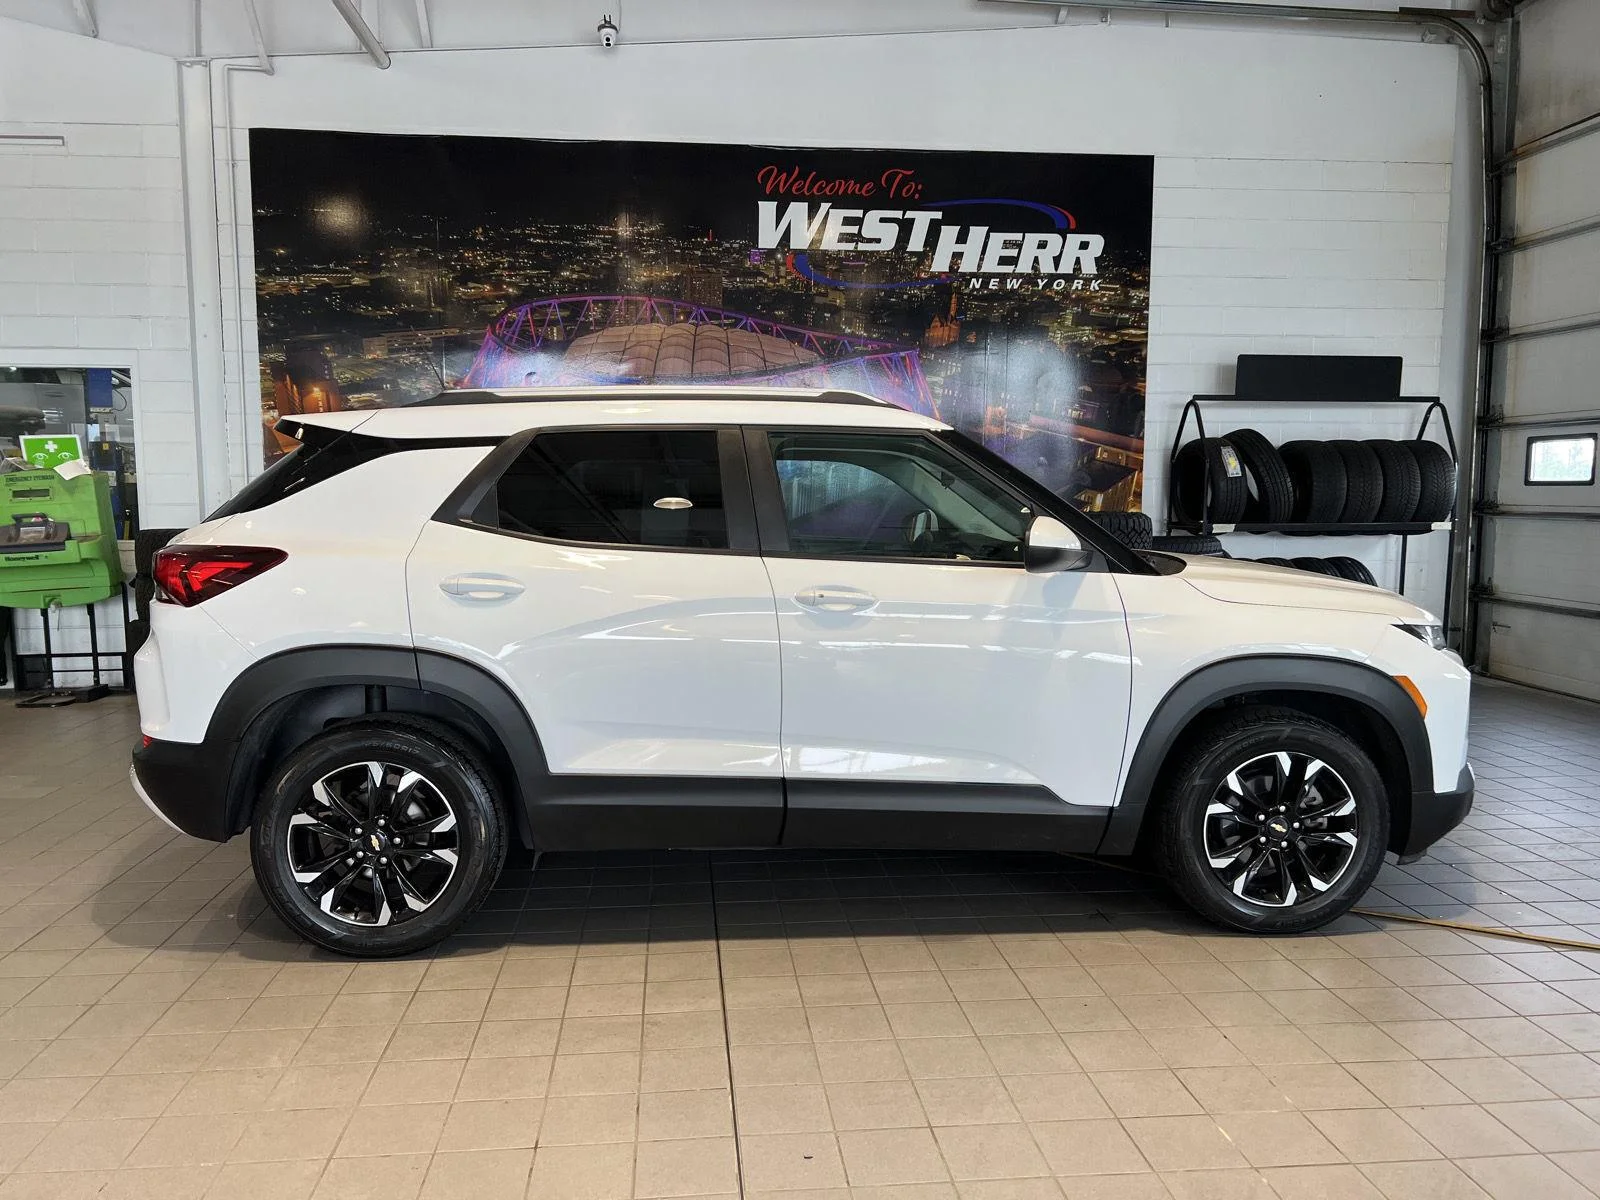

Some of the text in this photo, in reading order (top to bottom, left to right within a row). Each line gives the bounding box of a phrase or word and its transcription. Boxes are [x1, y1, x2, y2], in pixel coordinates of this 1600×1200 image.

[757, 165, 922, 199] Welcome To:
[757, 200, 1105, 275] WEST HERR
[969, 278, 1102, 291] NEW YORK
